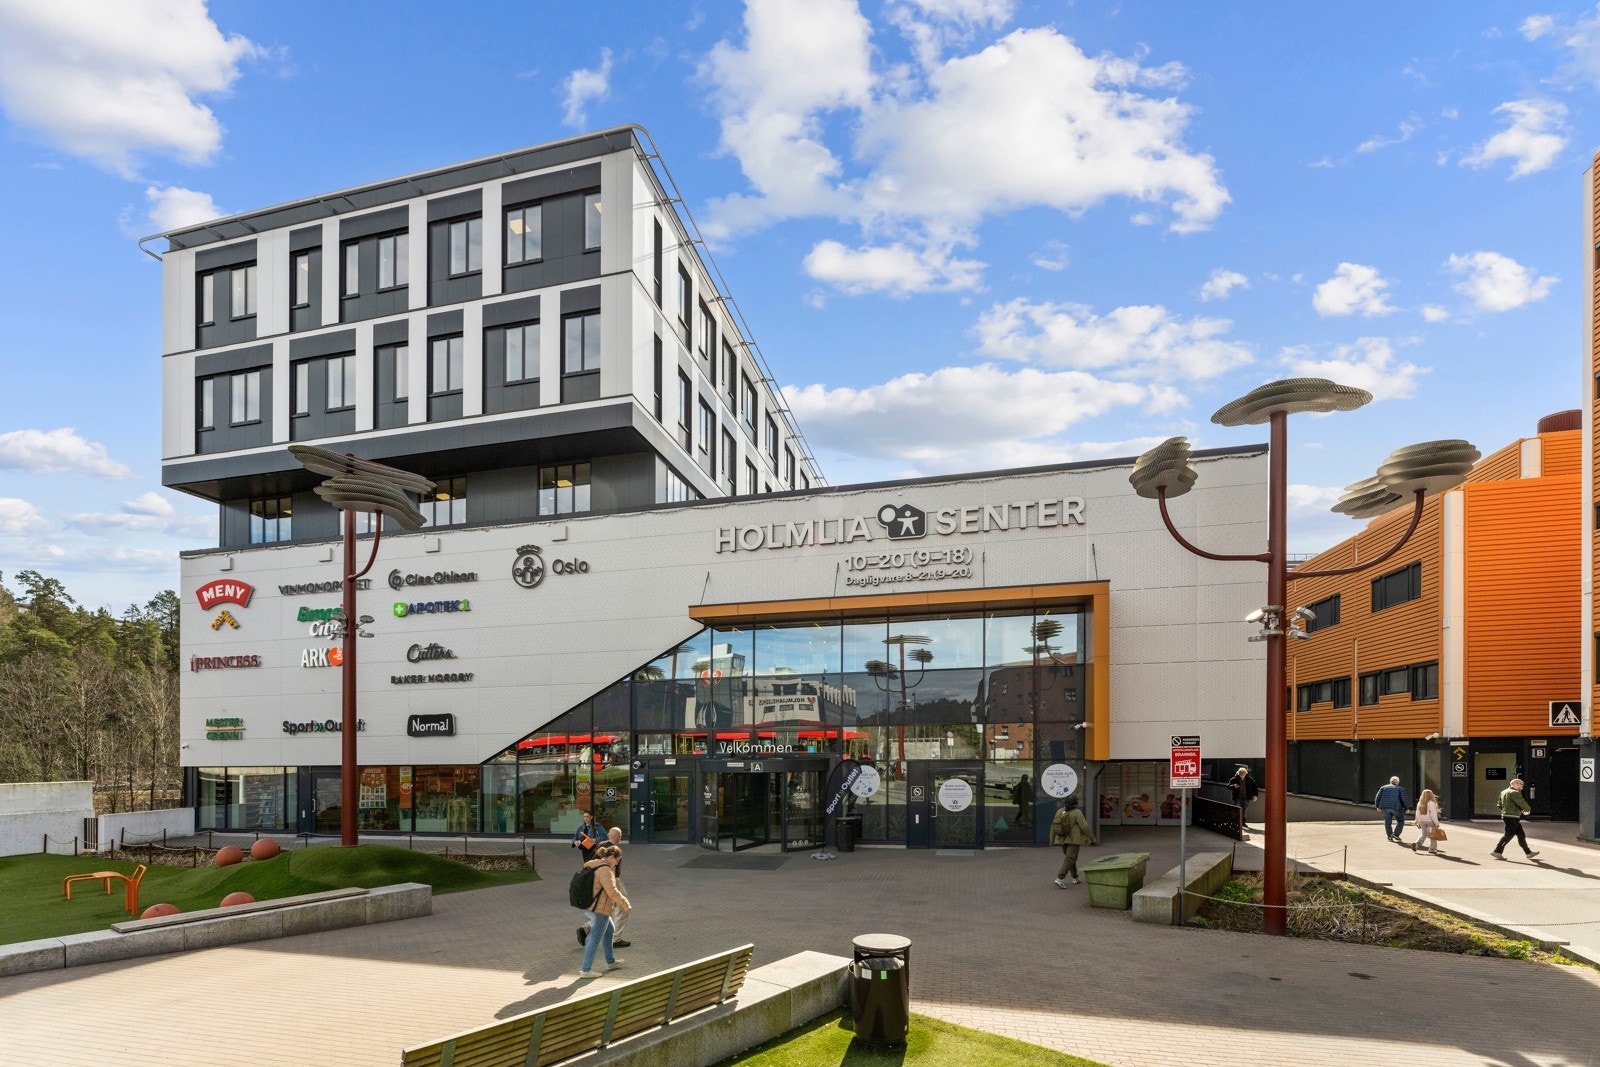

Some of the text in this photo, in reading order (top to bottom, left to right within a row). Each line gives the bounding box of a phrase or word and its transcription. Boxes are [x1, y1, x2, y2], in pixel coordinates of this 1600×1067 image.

[716, 496, 1086, 554] HOLMLIA SENTER
[552, 558, 589, 575] Oslo
[406, 571, 477, 586] Clas Ohlson
[846, 573, 901, 587] Dagligvare
[202, 584, 245, 602] MENY
[309, 622, 342, 640] City
[301, 649, 329, 667] ARK
[407, 643, 452, 663] Cutters
[195, 655, 261, 670] PRINCESS
[391, 675, 425, 684] BAKER
[282, 720, 316, 735] Sport
[412, 718, 449, 732] Normal
[720, 742, 793, 754] Velkommen
[826, 768, 859, 814] Sport Outlet
